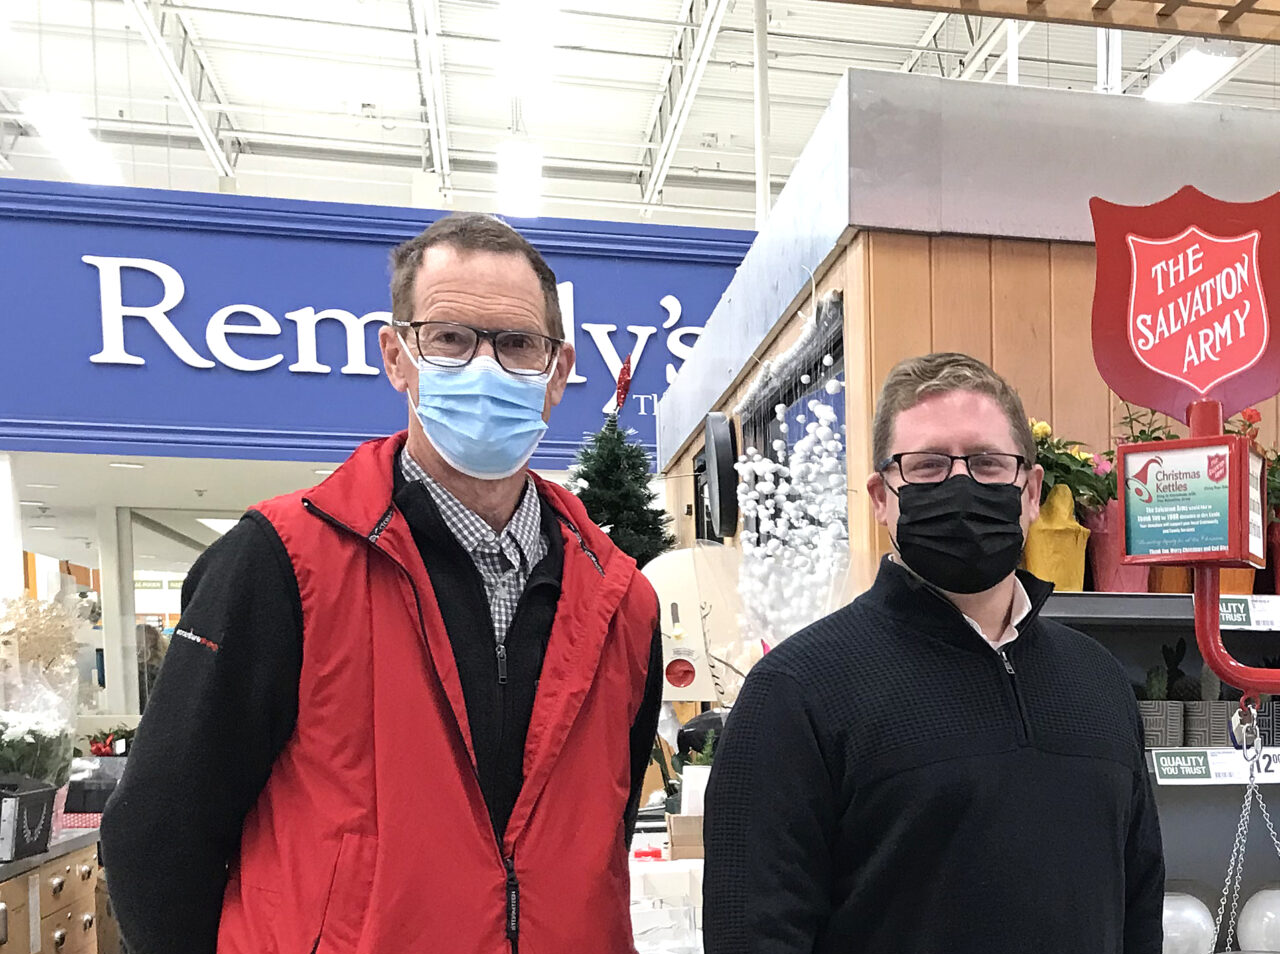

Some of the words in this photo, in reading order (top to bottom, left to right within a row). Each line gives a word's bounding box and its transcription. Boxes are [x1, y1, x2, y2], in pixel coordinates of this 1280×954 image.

[1152, 244, 1204, 295] THE
[1136, 253, 1249, 350] SALVATION
[81, 255, 705, 413] Remy's
[1183, 300, 1250, 373] ARMY
[1155, 470, 1201, 482] Christmas
[1156, 482, 1188, 493] Kettles
[1221, 613, 1247, 622] TRUST
[1160, 756, 1205, 767] QUALITY
[1161, 767, 1178, 775] YOU
[1180, 766, 1206, 774] TRUST
